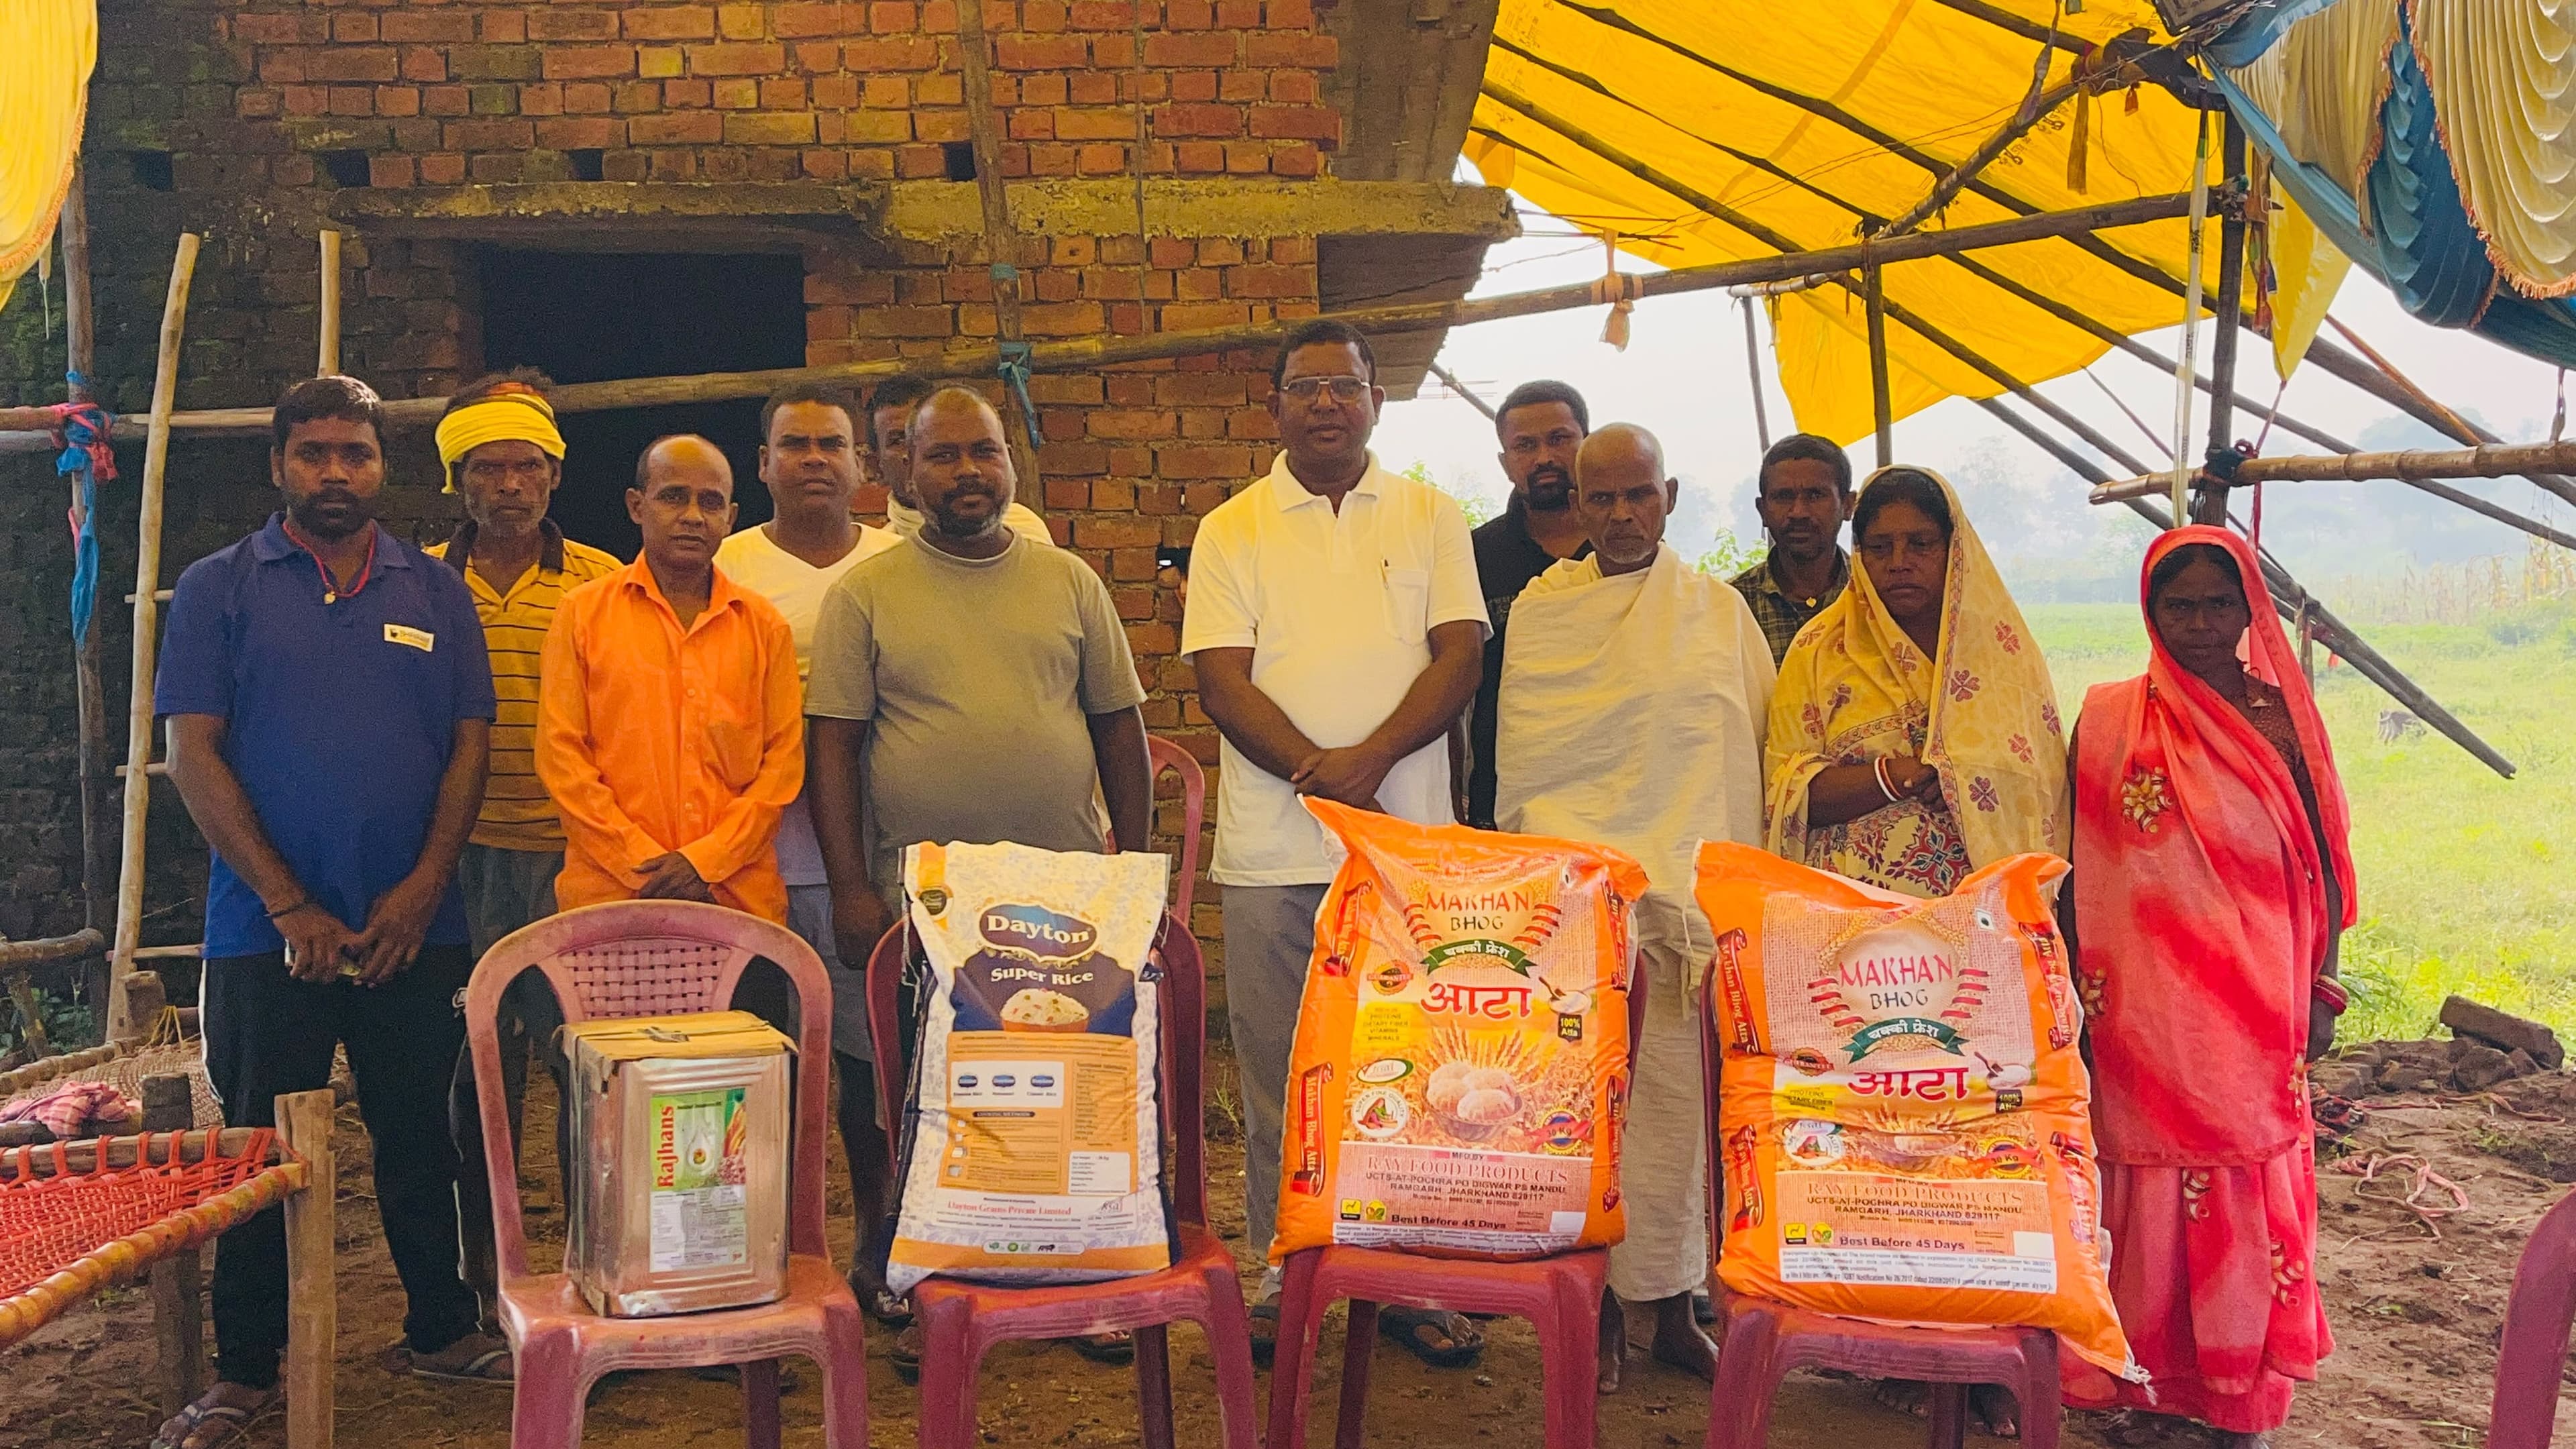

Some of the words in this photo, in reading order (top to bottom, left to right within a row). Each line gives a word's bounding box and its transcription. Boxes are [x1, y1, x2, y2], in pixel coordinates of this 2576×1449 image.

[1426, 891, 1529, 912] MAKHAN
[987, 915, 1089, 944] Dayton
[1451, 916, 1503, 931] BHOG
[991, 967, 1046, 982] Super
[1052, 972, 1093, 985] Rice
[1839, 954, 1953, 987] MAKHAN
[1421, 982, 1532, 1019] आटा
[1870, 989, 1929, 1010] BHOG
[1560, 1018, 1580, 1028] 100%
[1737, 1021, 1748, 1042] Atta
[1848, 1067, 1969, 1100] आटा
[1999, 1102, 2015, 1111] Att
[1304, 1121, 1317, 1148] Bhog
[657, 1106, 679, 1187] Rajhans
[1307, 1150, 1318, 1171] Atta
[1368, 1157, 1400, 1171] RAY
[1410, 1159, 1461, 1175] FOOD
[1469, 1164, 1568, 1182] PRODUCTS
[1447, 1187, 1509, 1199] JHARKHAND
[1809, 1183, 1843, 1194] RAY
[1854, 1185, 1907, 1197] FOOD
[1915, 1187, 2022, 1203] PRODUCTS
[1391, 1214, 1417, 1224] Best
[1421, 1215, 1458, 1226] Before
[1462, 1220, 1475, 1228] 45
[1478, 1220, 1506, 1230] Days
[1895, 1208, 1962, 1219] JHARKHAND
[1840, 1236, 1868, 1246] Best
[1872, 1237, 1911, 1248] Before
[1916, 1240, 1931, 1248] 45
[1935, 1240, 1965, 1251] Days
